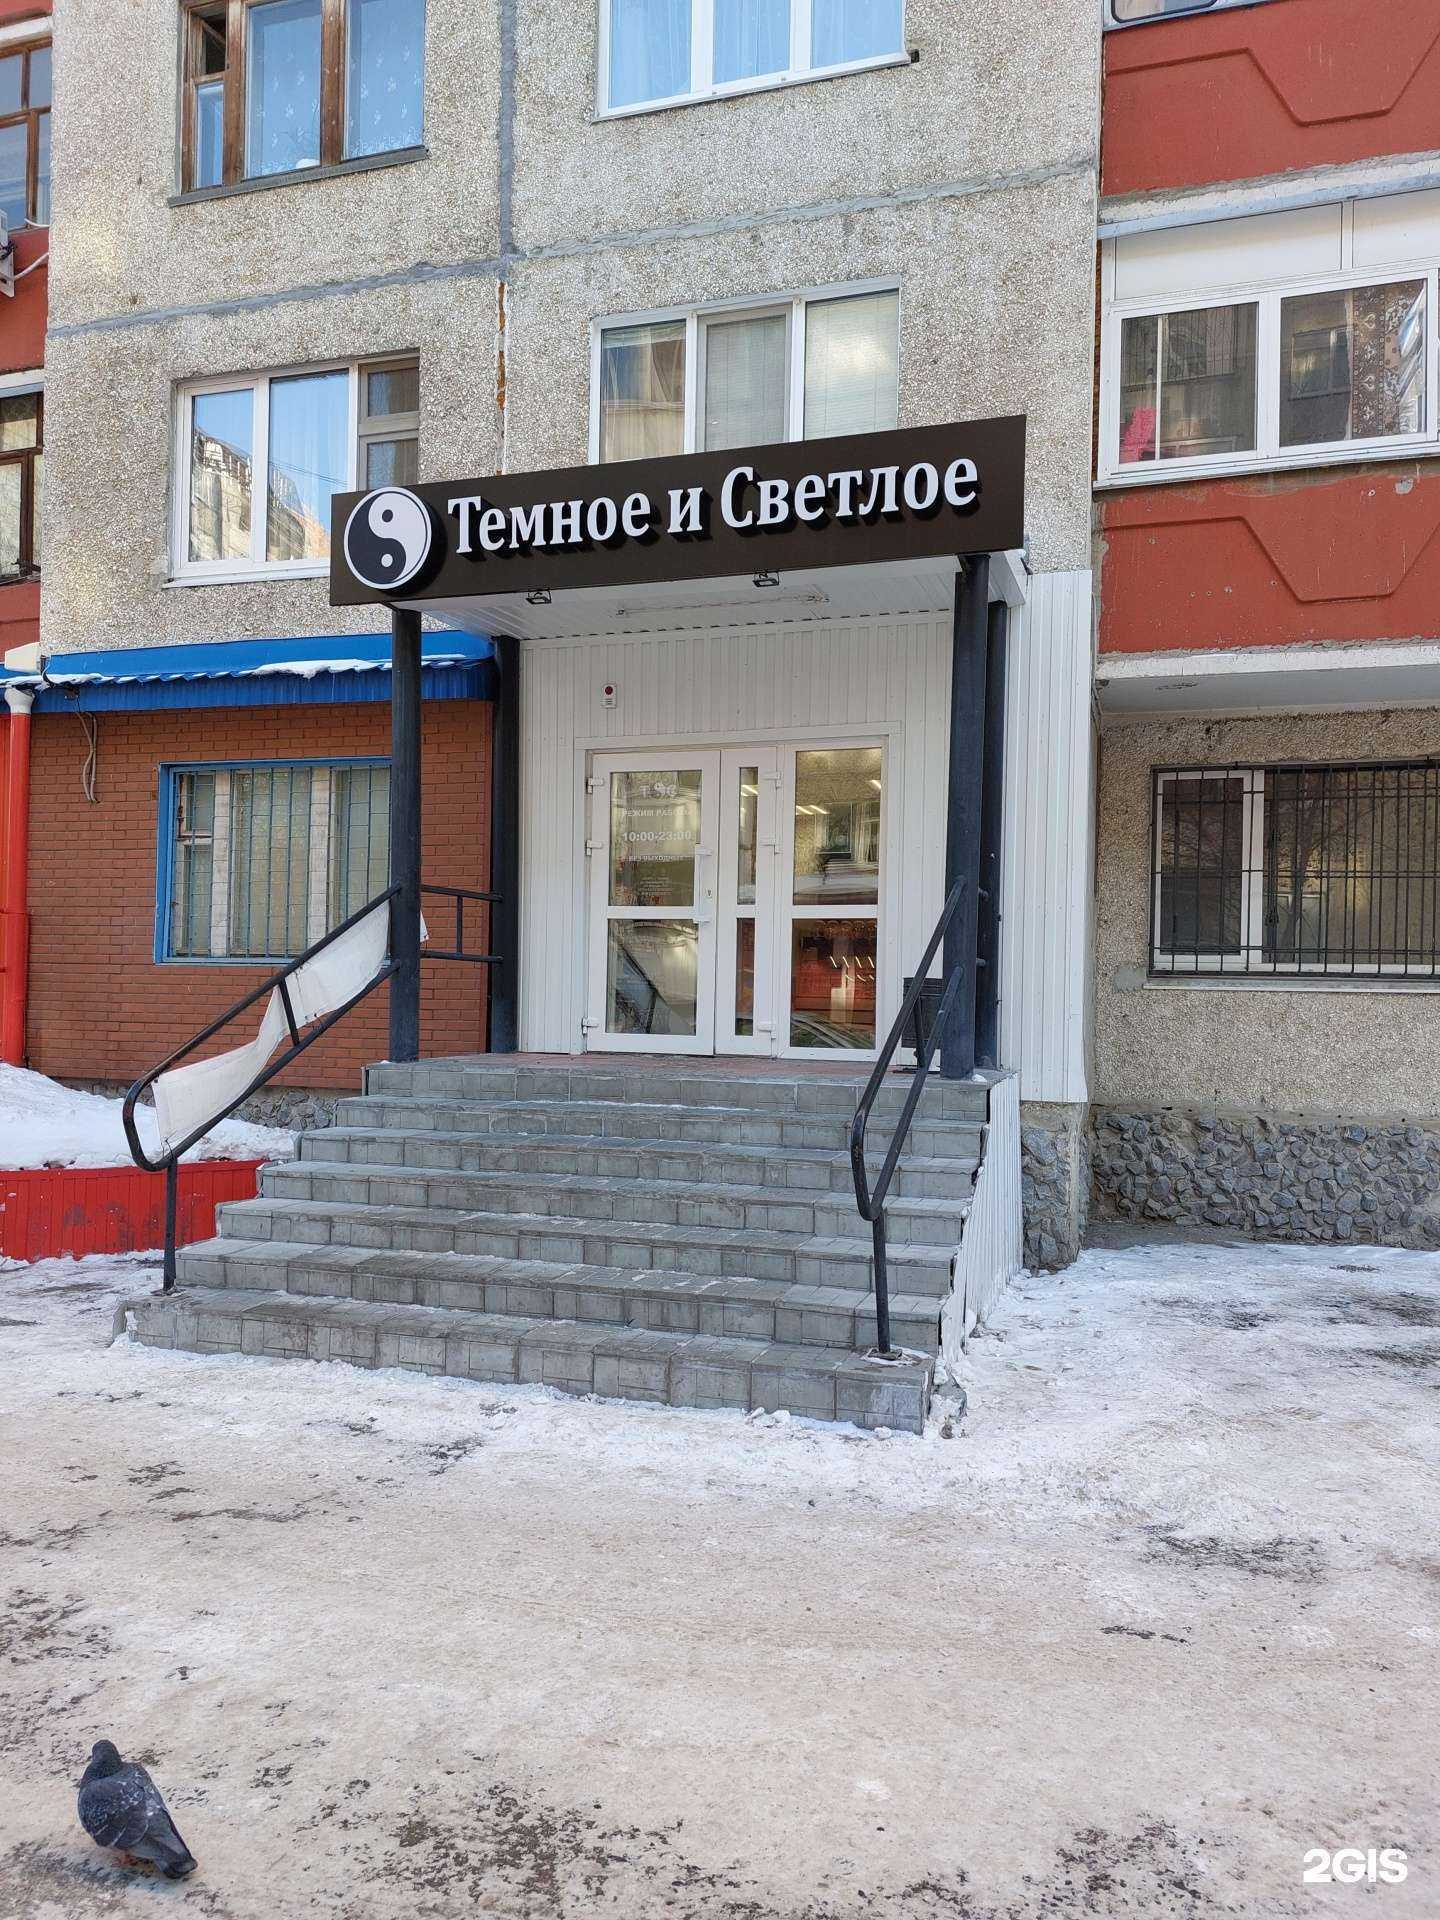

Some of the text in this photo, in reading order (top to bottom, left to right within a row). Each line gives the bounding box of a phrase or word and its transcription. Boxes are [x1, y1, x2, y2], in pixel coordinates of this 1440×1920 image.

[447, 458, 978, 554] Темное и Светлое
[623, 831, 692, 842] 10:00-23:00
